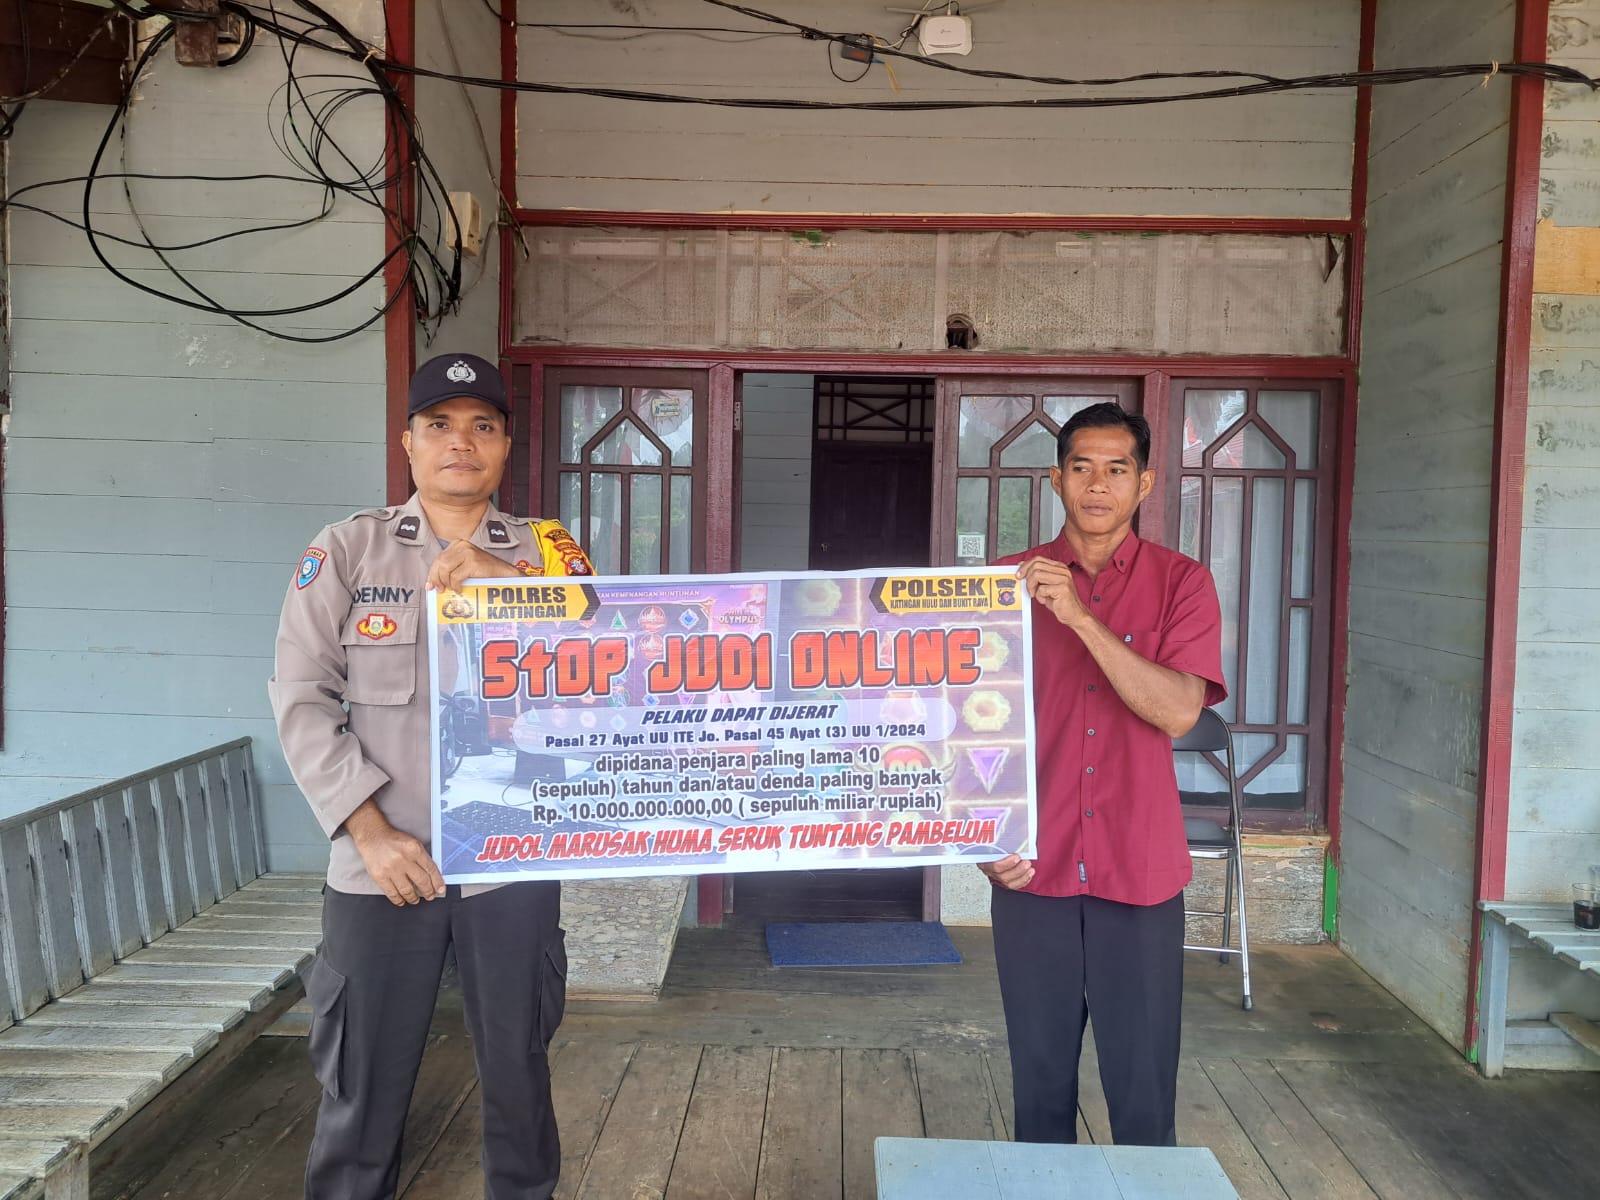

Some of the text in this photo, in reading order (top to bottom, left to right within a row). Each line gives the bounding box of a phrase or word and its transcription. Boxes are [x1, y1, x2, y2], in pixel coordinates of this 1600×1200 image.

[353, 587, 414, 603] DENNY
[487, 586, 566, 604] POLRES
[891, 578, 985, 598] POLSEK
[487, 604, 566, 619] KATINGAN
[890, 600, 920, 609] KATINGAN
[922, 599, 938, 608] HULU
[953, 598, 972, 608] BUKIT
[718, 615, 760, 624] OLYMPUS
[649, 632, 772, 694] JUDI
[790, 628, 981, 690] ONLINE
[642, 704, 838, 725] PELAKU DAPAT DIJERAT
[545, 724, 926, 748] Pasal 27 Ayat UU ITE Jo. Pasal 45 Ayat (3) UU 1/2024
[596, 746, 880, 775] dipidana penjara paling lama 10
[532, 768, 942, 803] (sepuluh) tahun dan/atau denda paling banyak
[533, 806, 563, 824] Rp.
[568, 798, 733, 820] 10.000.000.000,00
[750, 795, 820, 816] sepuluh
[824, 793, 875, 810] miliar
[880, 792, 942, 812] rupiah)
[477, 818, 998, 863] JUDOL MARUSAK HUMA SERUK TUNTANG PAMBELUM
